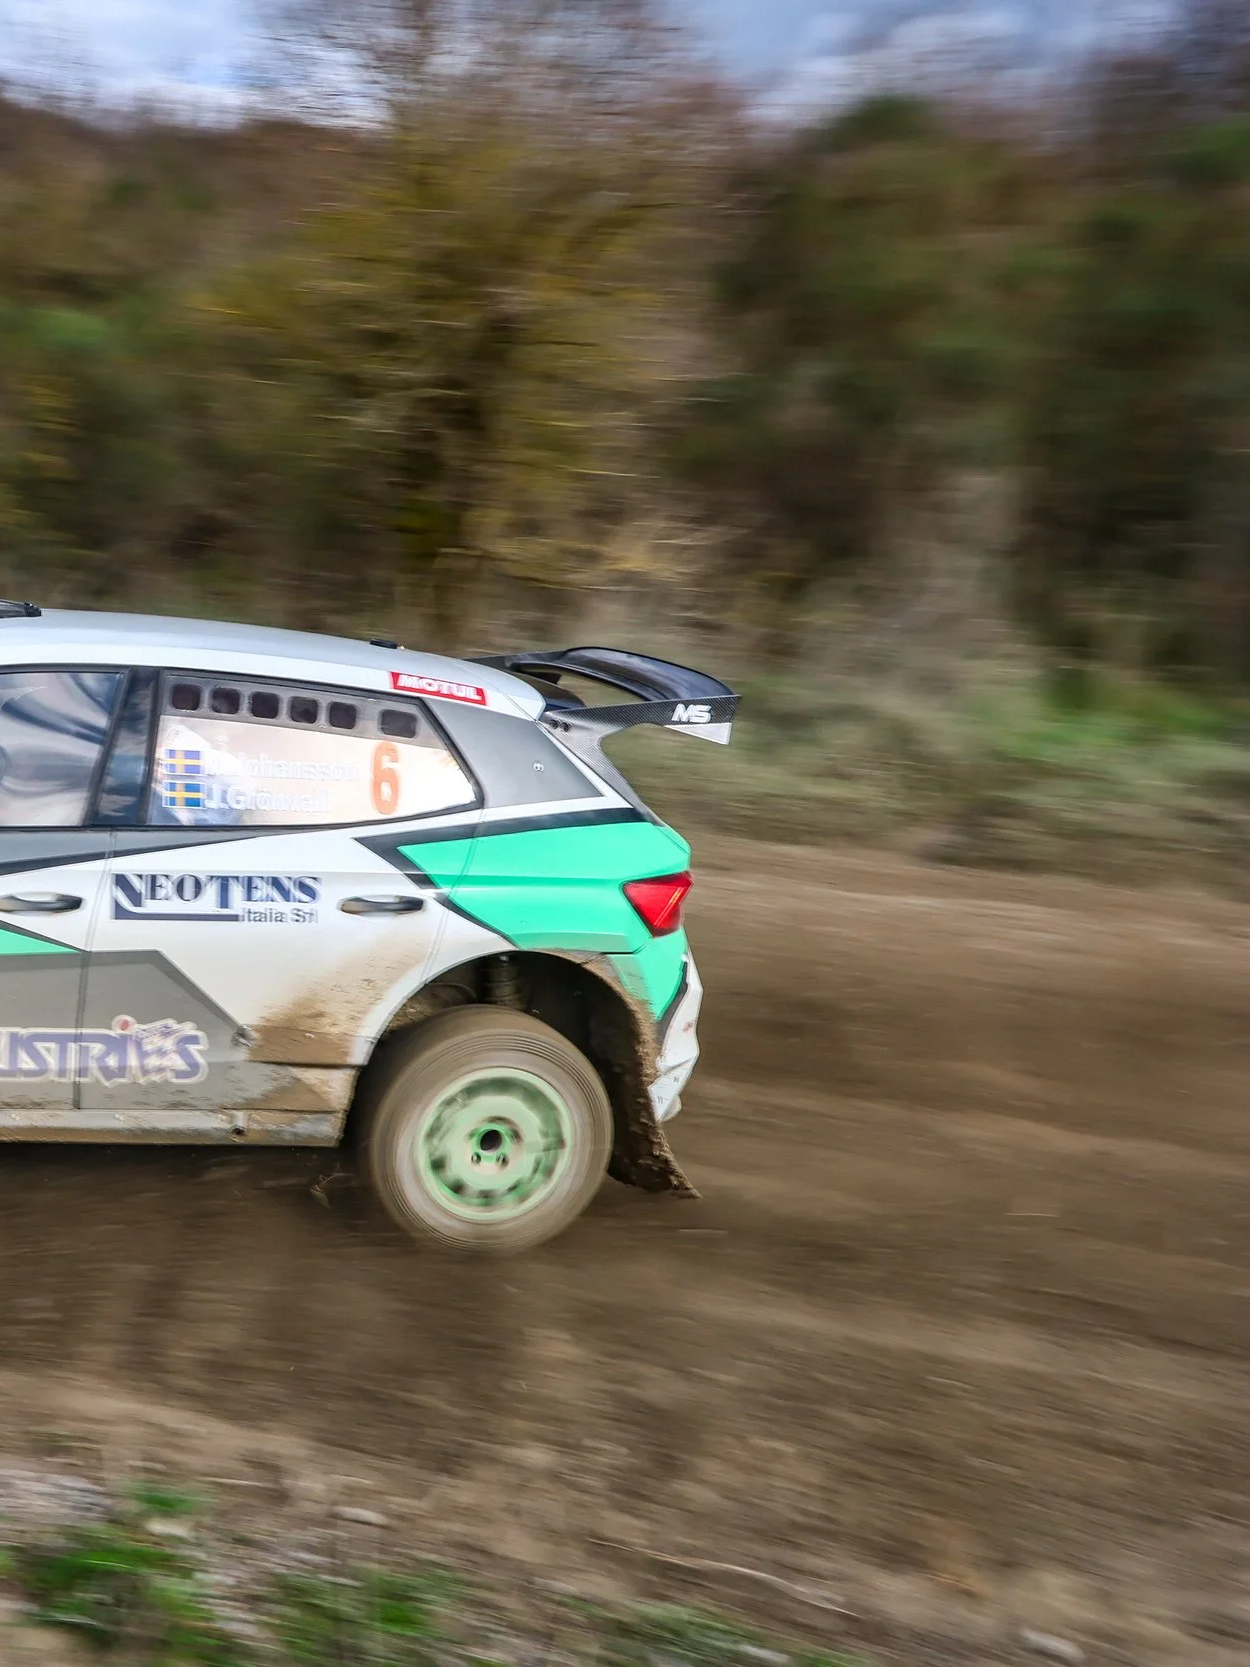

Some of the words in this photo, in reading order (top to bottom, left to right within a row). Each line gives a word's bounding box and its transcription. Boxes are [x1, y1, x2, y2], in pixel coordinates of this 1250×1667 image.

[398, 674, 481, 701] MOTUL
[671, 703, 712, 723] MS
[371, 741, 401, 815] 6
[112, 873, 322, 910] NEOTENS
